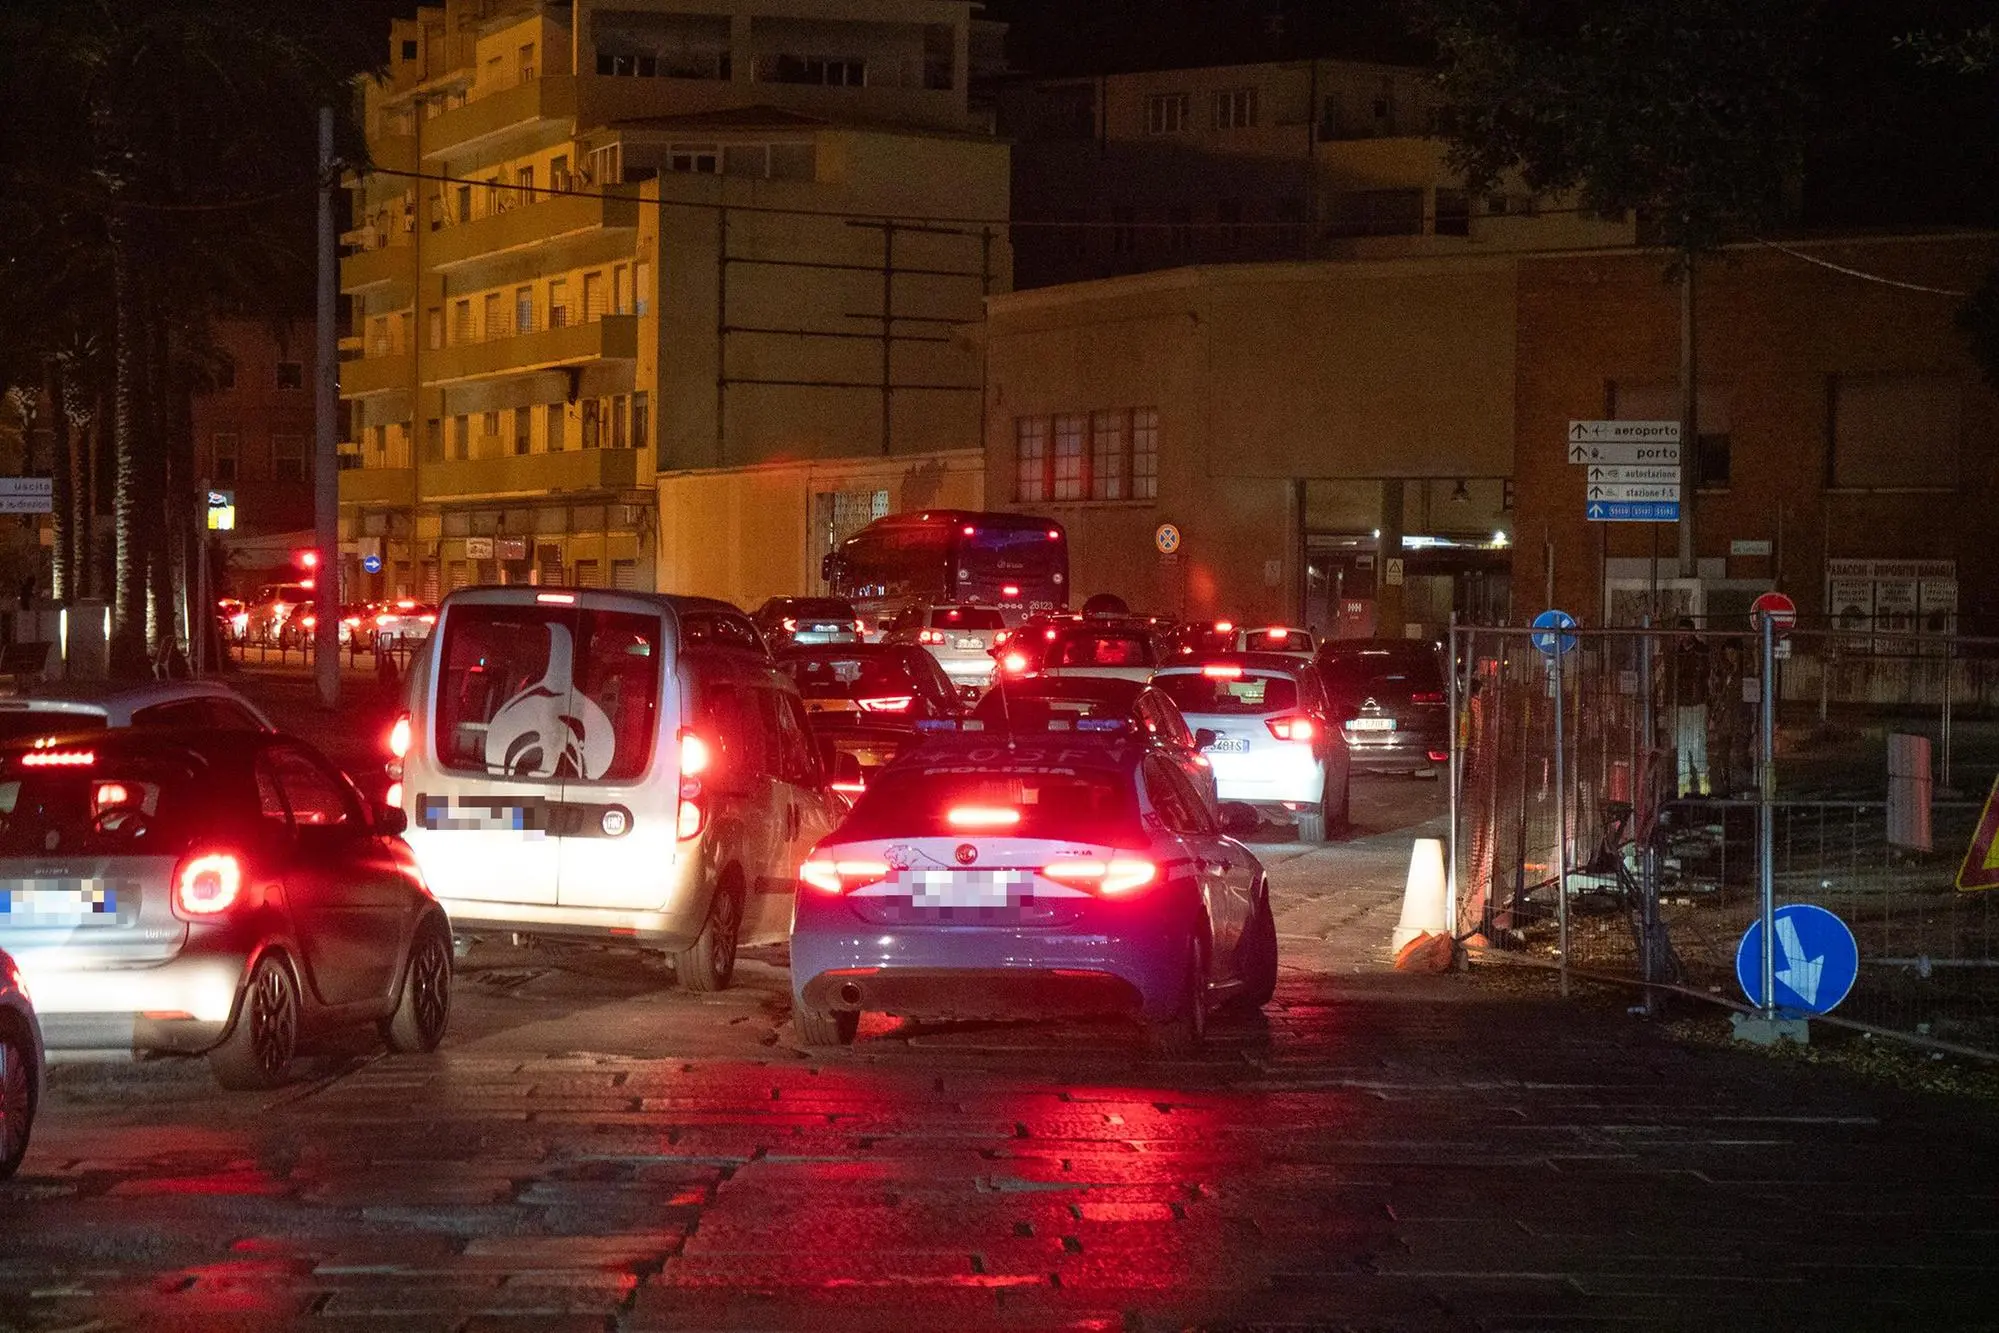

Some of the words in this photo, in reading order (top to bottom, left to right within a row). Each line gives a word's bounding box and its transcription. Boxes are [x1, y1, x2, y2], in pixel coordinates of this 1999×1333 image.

[1615, 426, 1678, 436] aeroporto
[1637, 447, 1678, 459] porto
[1626, 468, 1677, 479] autostazione
[1626, 488, 1660, 497] stazione
[1028, 600, 1054, 610] 26123
[923, 766, 1075, 777] POLIZIA
